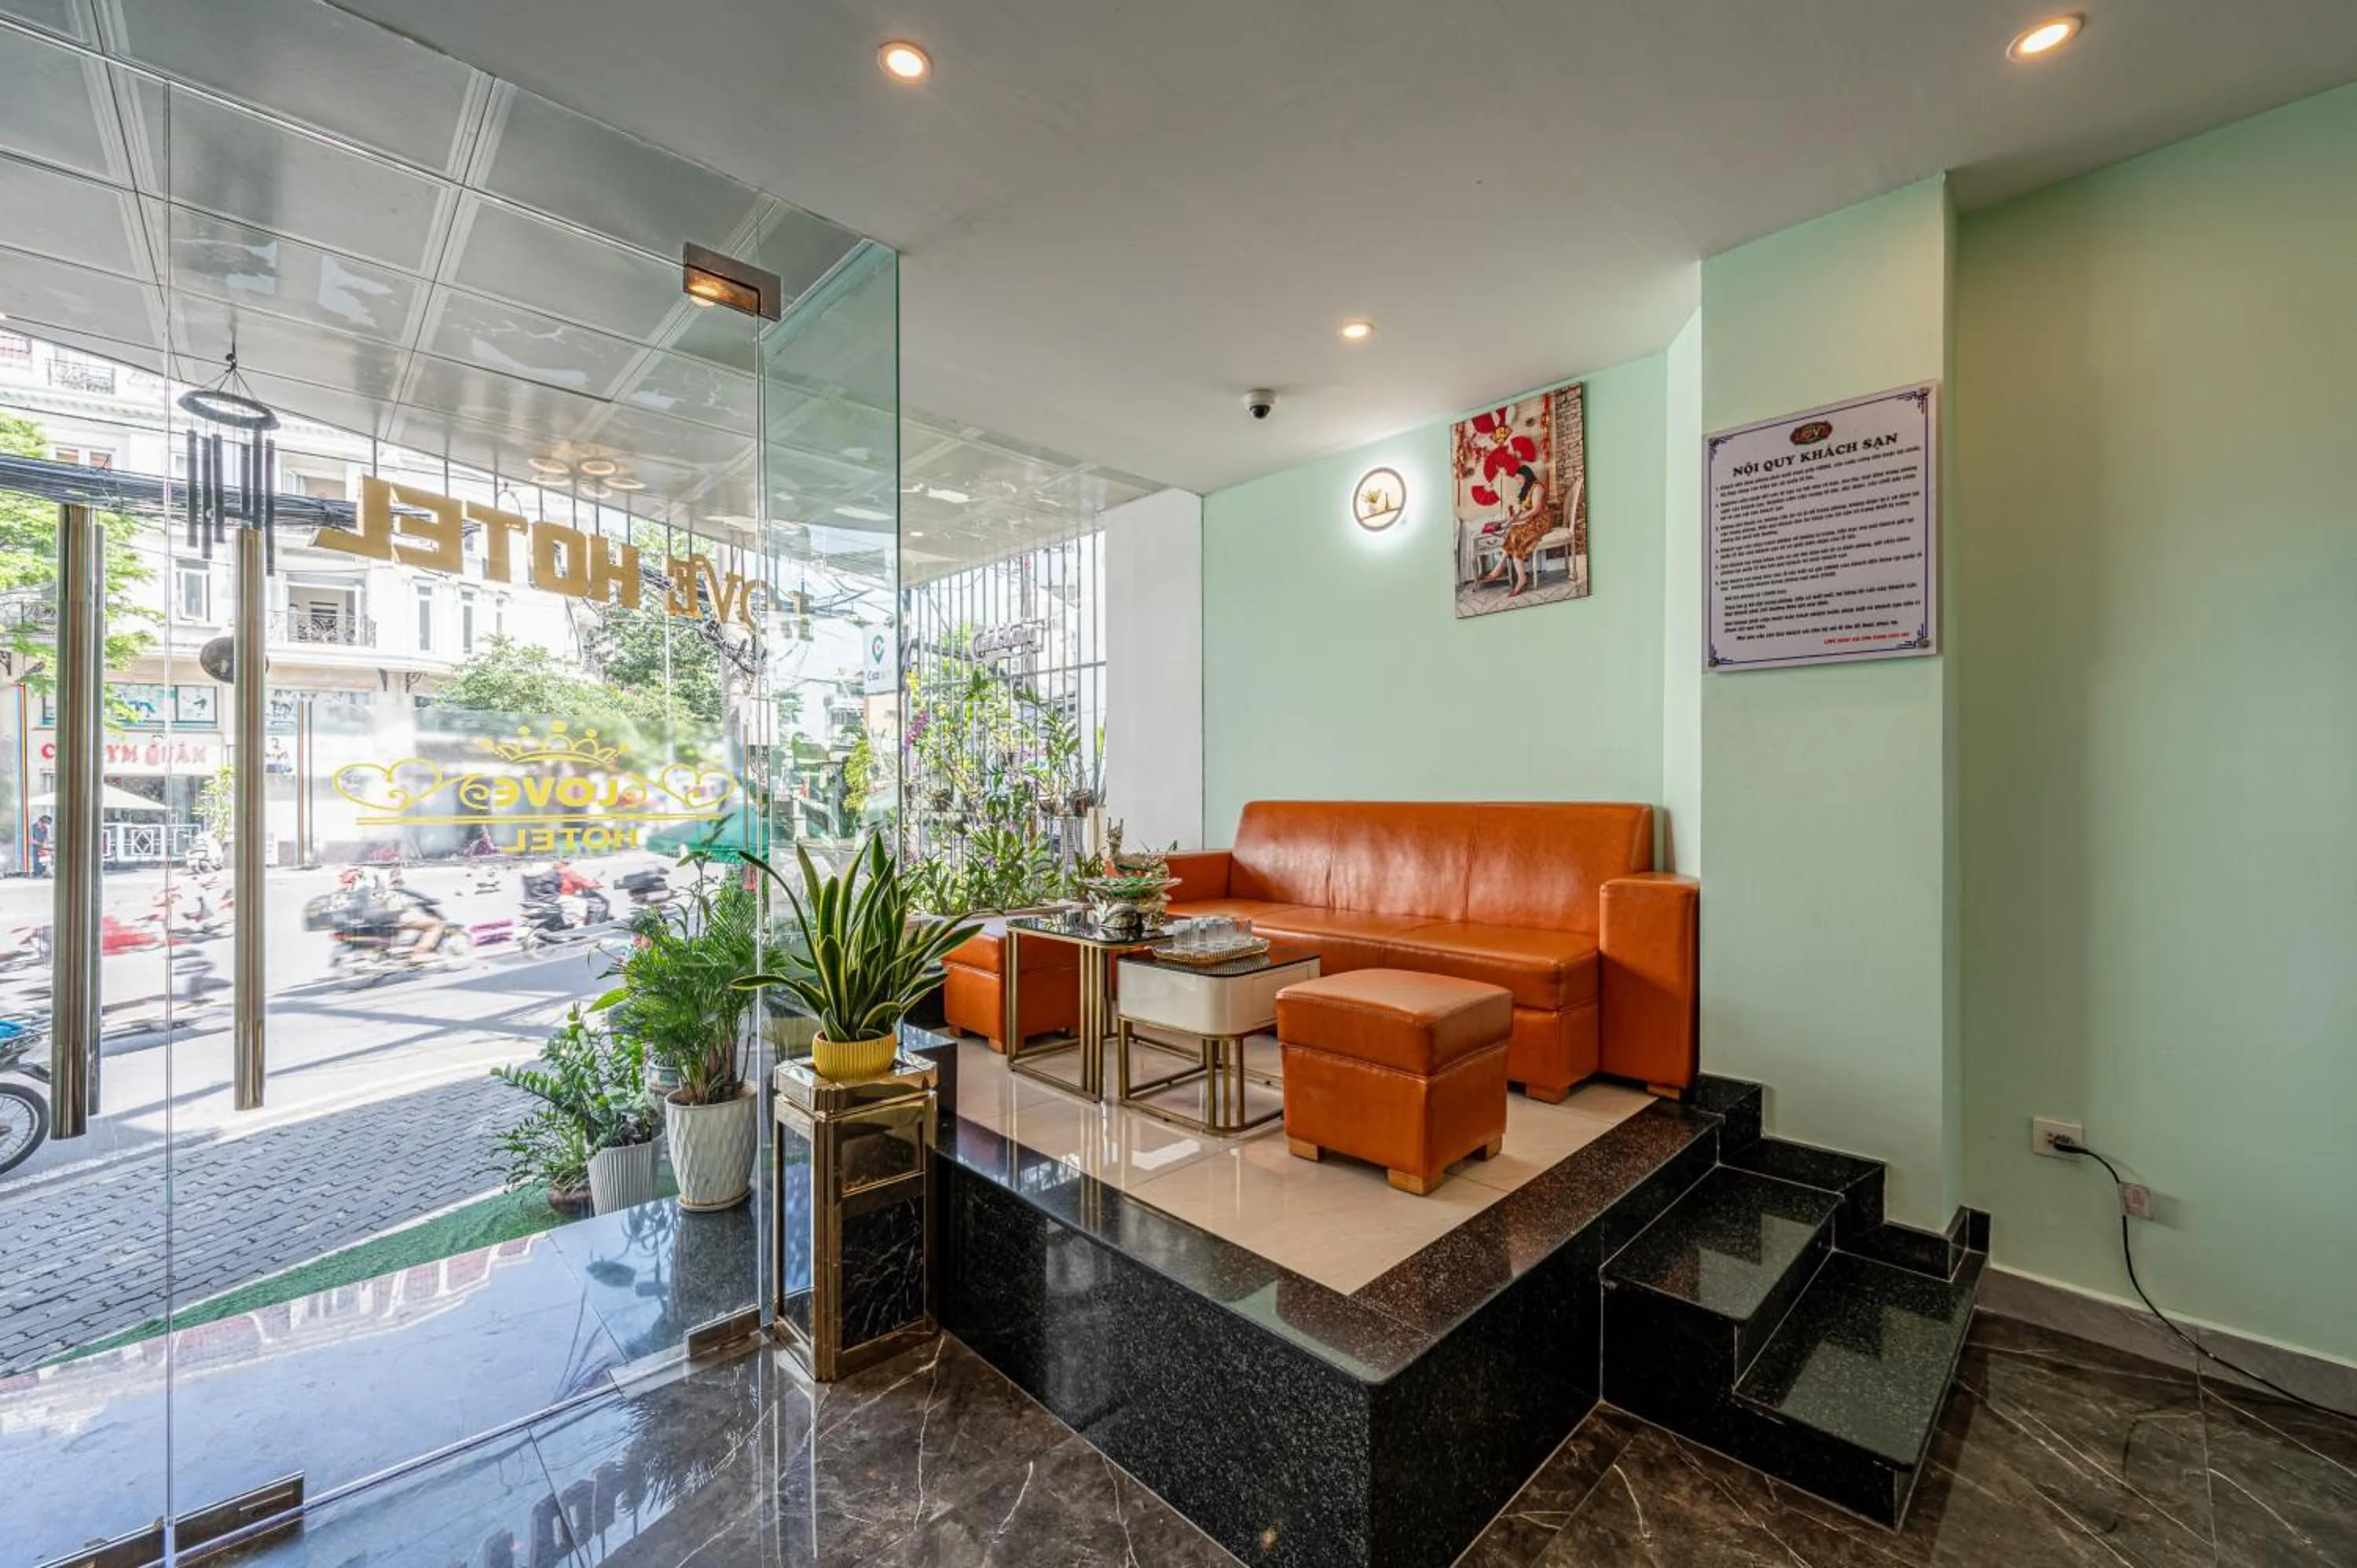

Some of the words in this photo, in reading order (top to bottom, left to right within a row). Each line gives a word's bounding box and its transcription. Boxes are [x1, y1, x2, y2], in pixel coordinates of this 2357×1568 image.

[1732, 460, 1759, 476] NỘI
[1763, 455, 1794, 471] QUY
[1800, 441, 1857, 462] KHÁCH
[1862, 433, 1898, 450] SẠN
